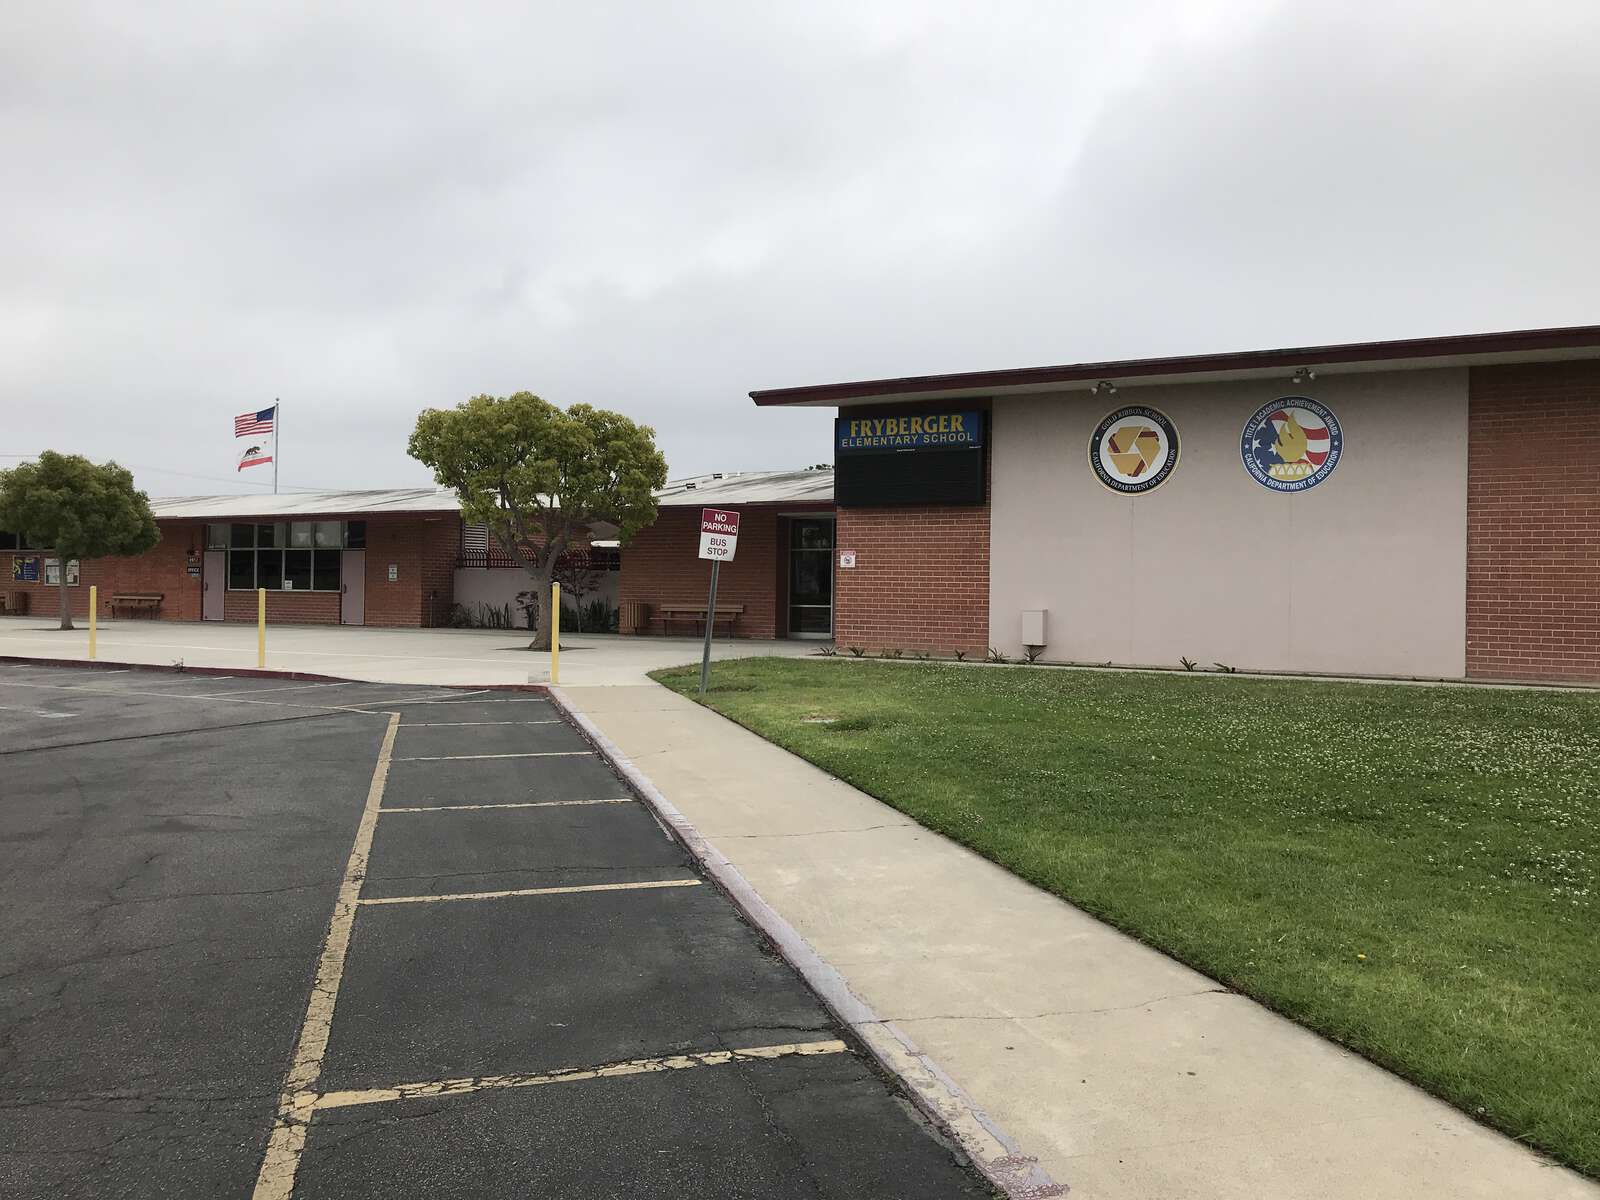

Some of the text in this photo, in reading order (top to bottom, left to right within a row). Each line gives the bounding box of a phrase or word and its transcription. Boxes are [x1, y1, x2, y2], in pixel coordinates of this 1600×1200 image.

[850, 415, 965, 437] FRYBERGER
[1102, 414, 1118, 430] GOLD
[1245, 423, 1256, 438] TITLE
[1256, 401, 1285, 422] ACADEMIC
[1287, 400, 1326, 417] ACHIEVEMENT
[1325, 416, 1338, 435] AWARD
[842, 432, 973, 447] ELEMENTARY SCHOOL
[1093, 449, 1176, 491] CALIFORNIA DEPARTMENT OF EDUCATION
[1245, 450, 1338, 490] CALIFORNIA DEPARTMENT OF EDUCATION
[714, 513, 727, 522] NO
[703, 521, 737, 533] PARKING
[710, 538, 727, 547] BUS
[707, 547, 728, 556] STOP
